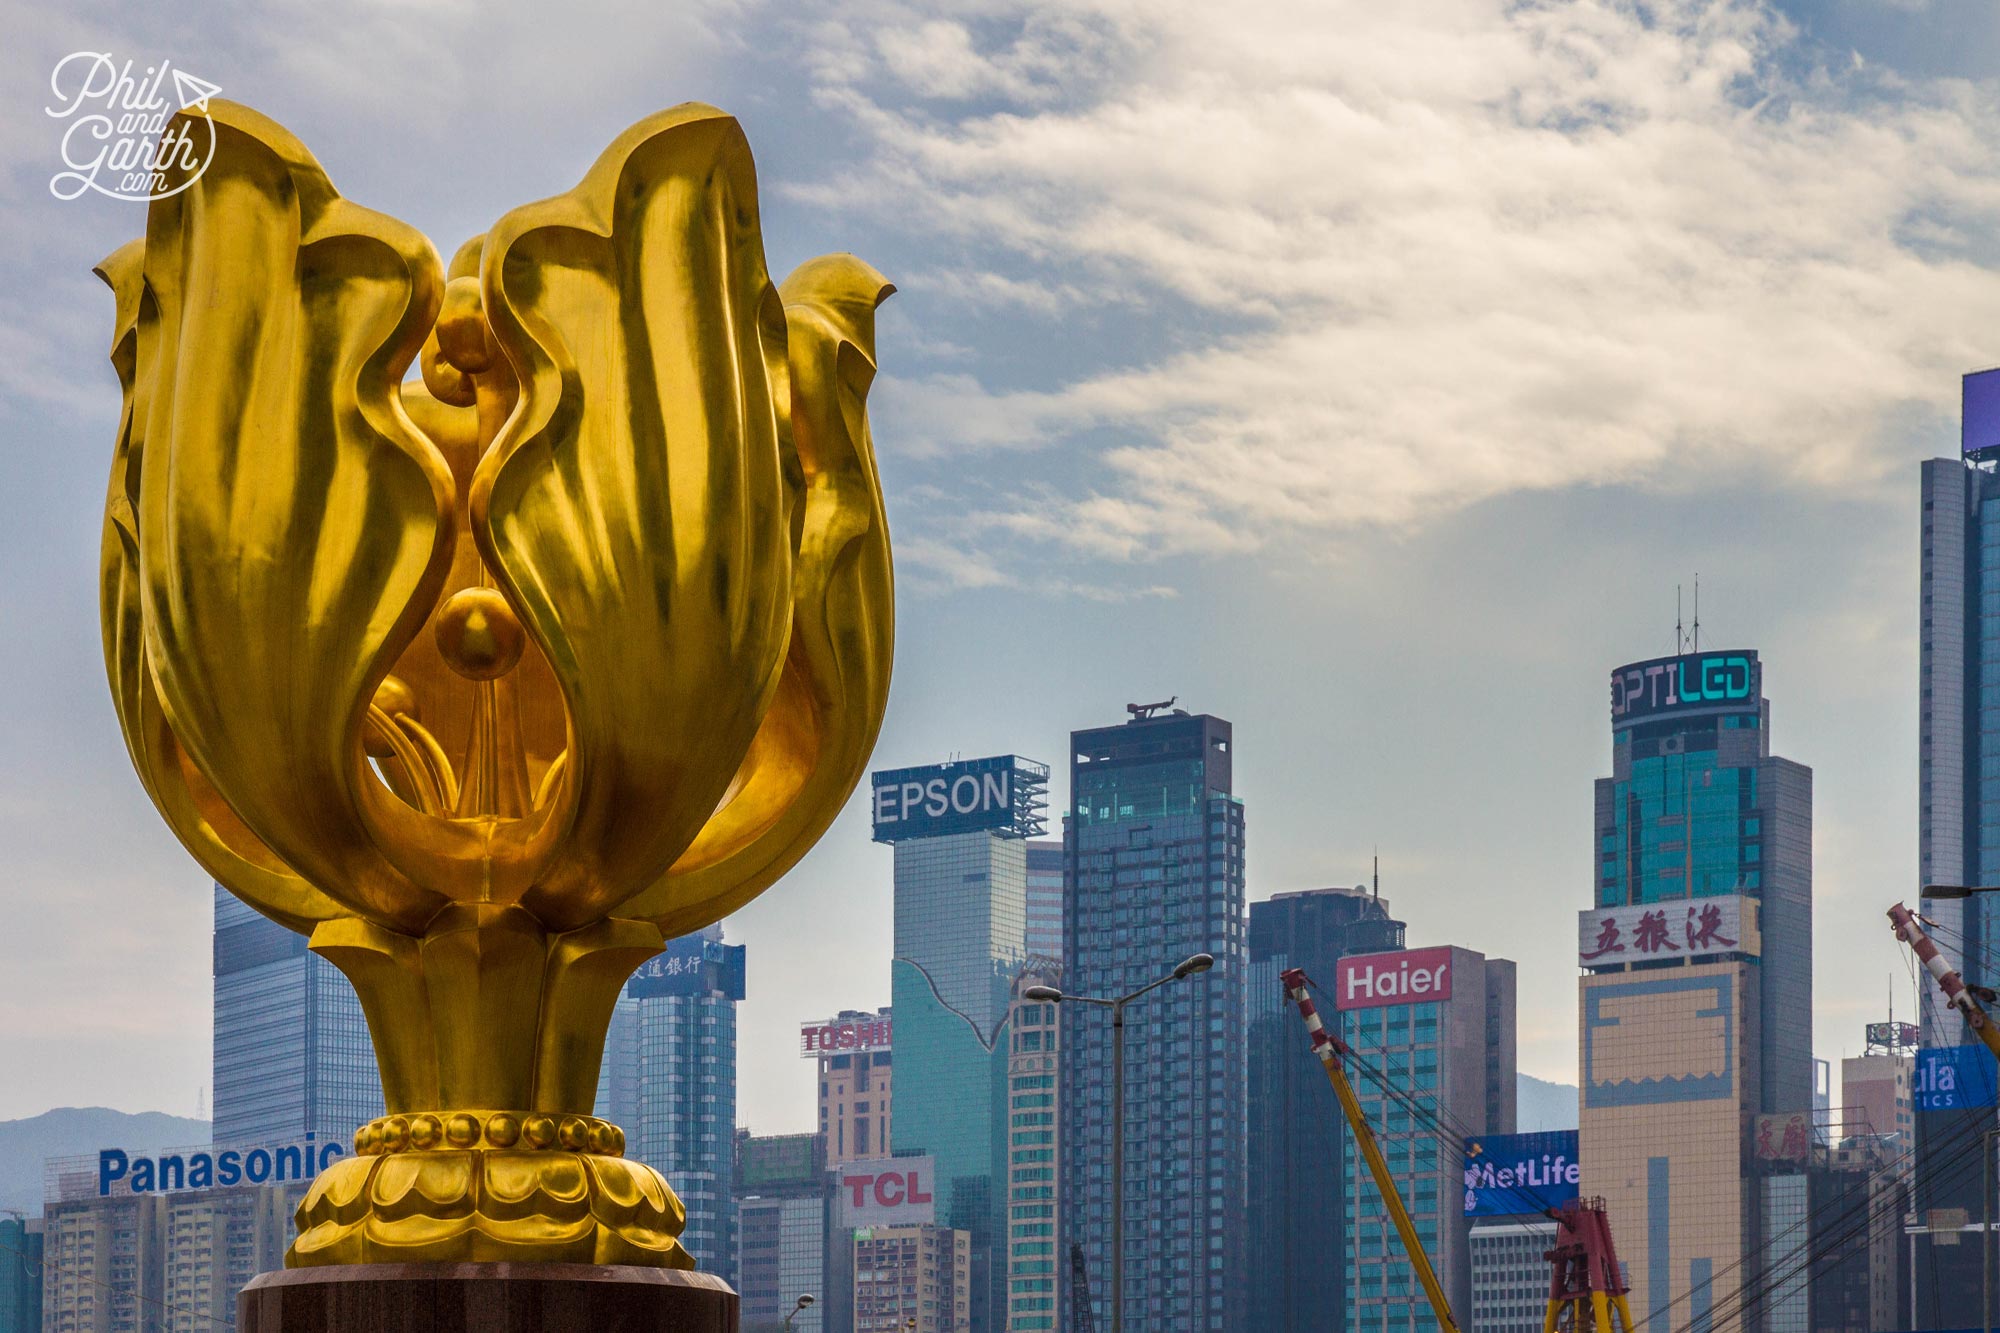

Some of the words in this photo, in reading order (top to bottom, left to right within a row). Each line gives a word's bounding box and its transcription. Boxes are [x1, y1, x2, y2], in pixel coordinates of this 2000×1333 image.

[1612, 657, 1750, 715] OPTILED
[875, 770, 1008, 824] EPSON
[1579, 903, 1738, 960] 五粮液
[1347, 960, 1447, 1000] Haier
[1915, 1094, 1953, 1107] ICS
[99, 1131, 344, 1196] Panasonic
[1471, 1154, 1579, 1190] MetLife
[843, 1172, 932, 1208] TCL
